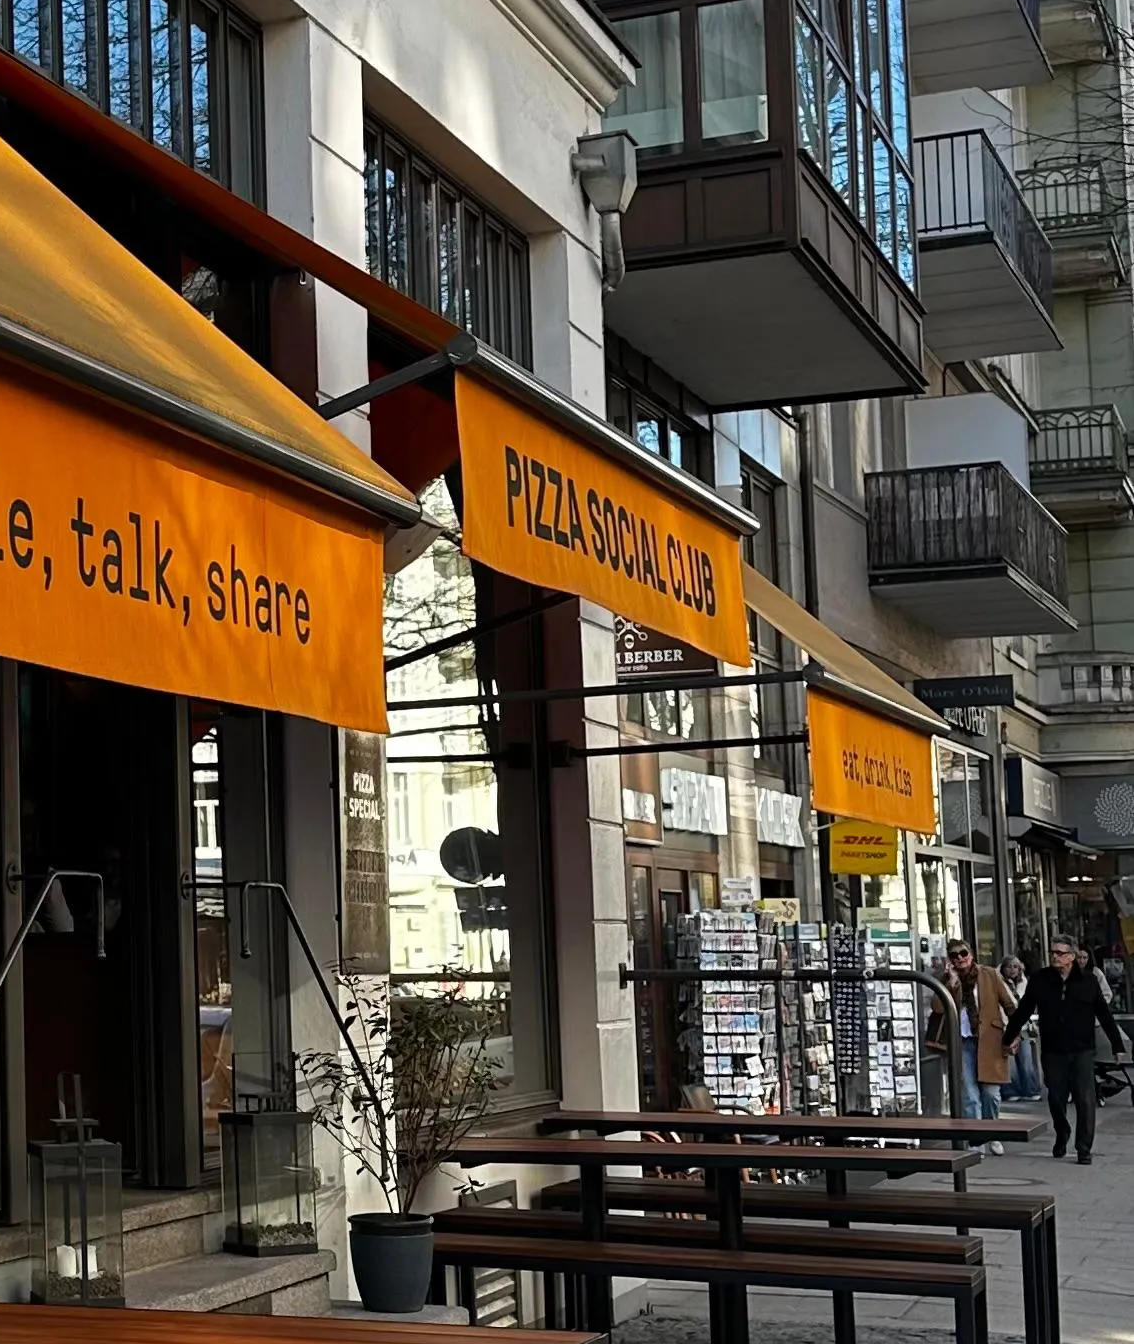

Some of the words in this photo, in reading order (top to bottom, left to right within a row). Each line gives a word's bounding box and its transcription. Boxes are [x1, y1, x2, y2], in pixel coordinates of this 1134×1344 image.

[505, 445, 588, 556] PIZZA
[587, 488, 667, 595] SOCIAL
[667, 534, 716, 617] CLUB
[71, 497, 190, 627] talk,
[207, 544, 310, 645] share
[624, 649, 684, 665] BERBER
[921, 687, 957, 699] Marc
[842, 743, 864, 789] eat,
[864, 747, 894, 796] drink,
[892, 755, 913, 797] kiss
[352, 772, 375, 795] PIZZA
[349, 798, 381, 821] SPECIAL
[842, 835, 883, 845] DHL
